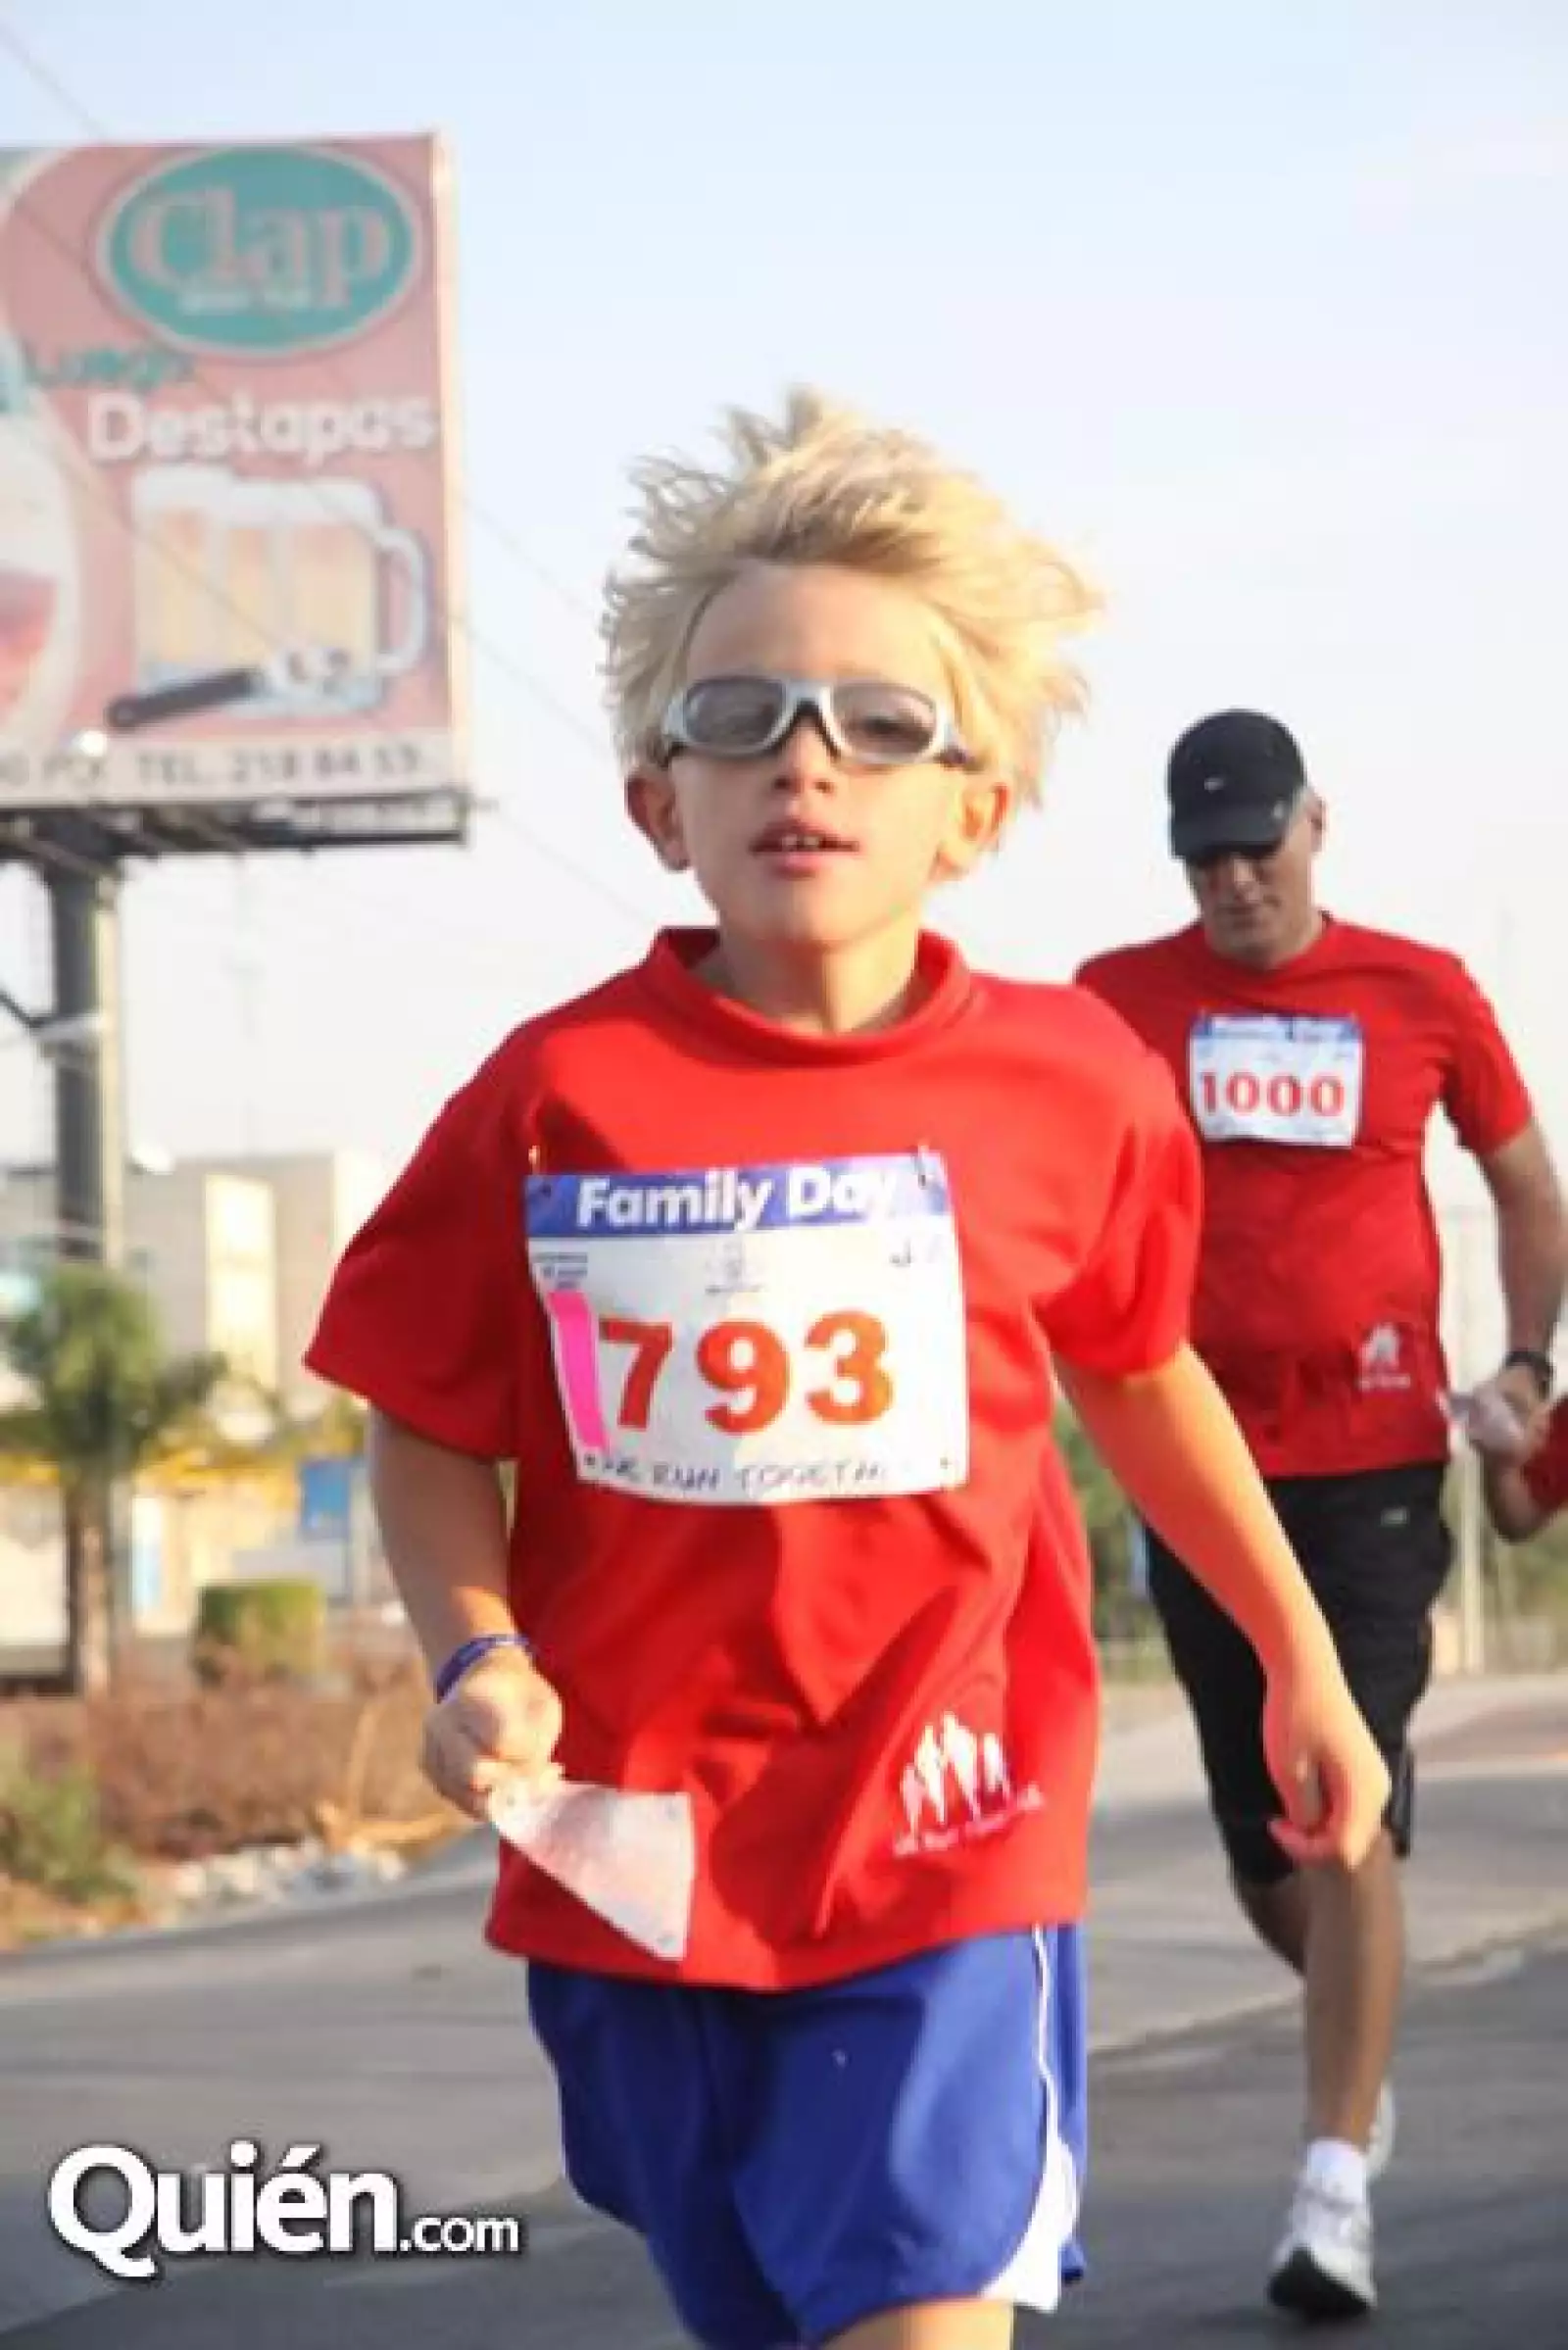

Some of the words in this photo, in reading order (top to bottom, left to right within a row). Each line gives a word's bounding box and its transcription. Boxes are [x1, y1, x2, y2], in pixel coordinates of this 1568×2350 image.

[127, 189, 387, 309] Clap
[89, 393, 436, 469] Destapas
[1200, 1070, 1345, 1117] 1000
[576, 1168, 772, 1232] Family
[598, 1308, 895, 1436] 793
